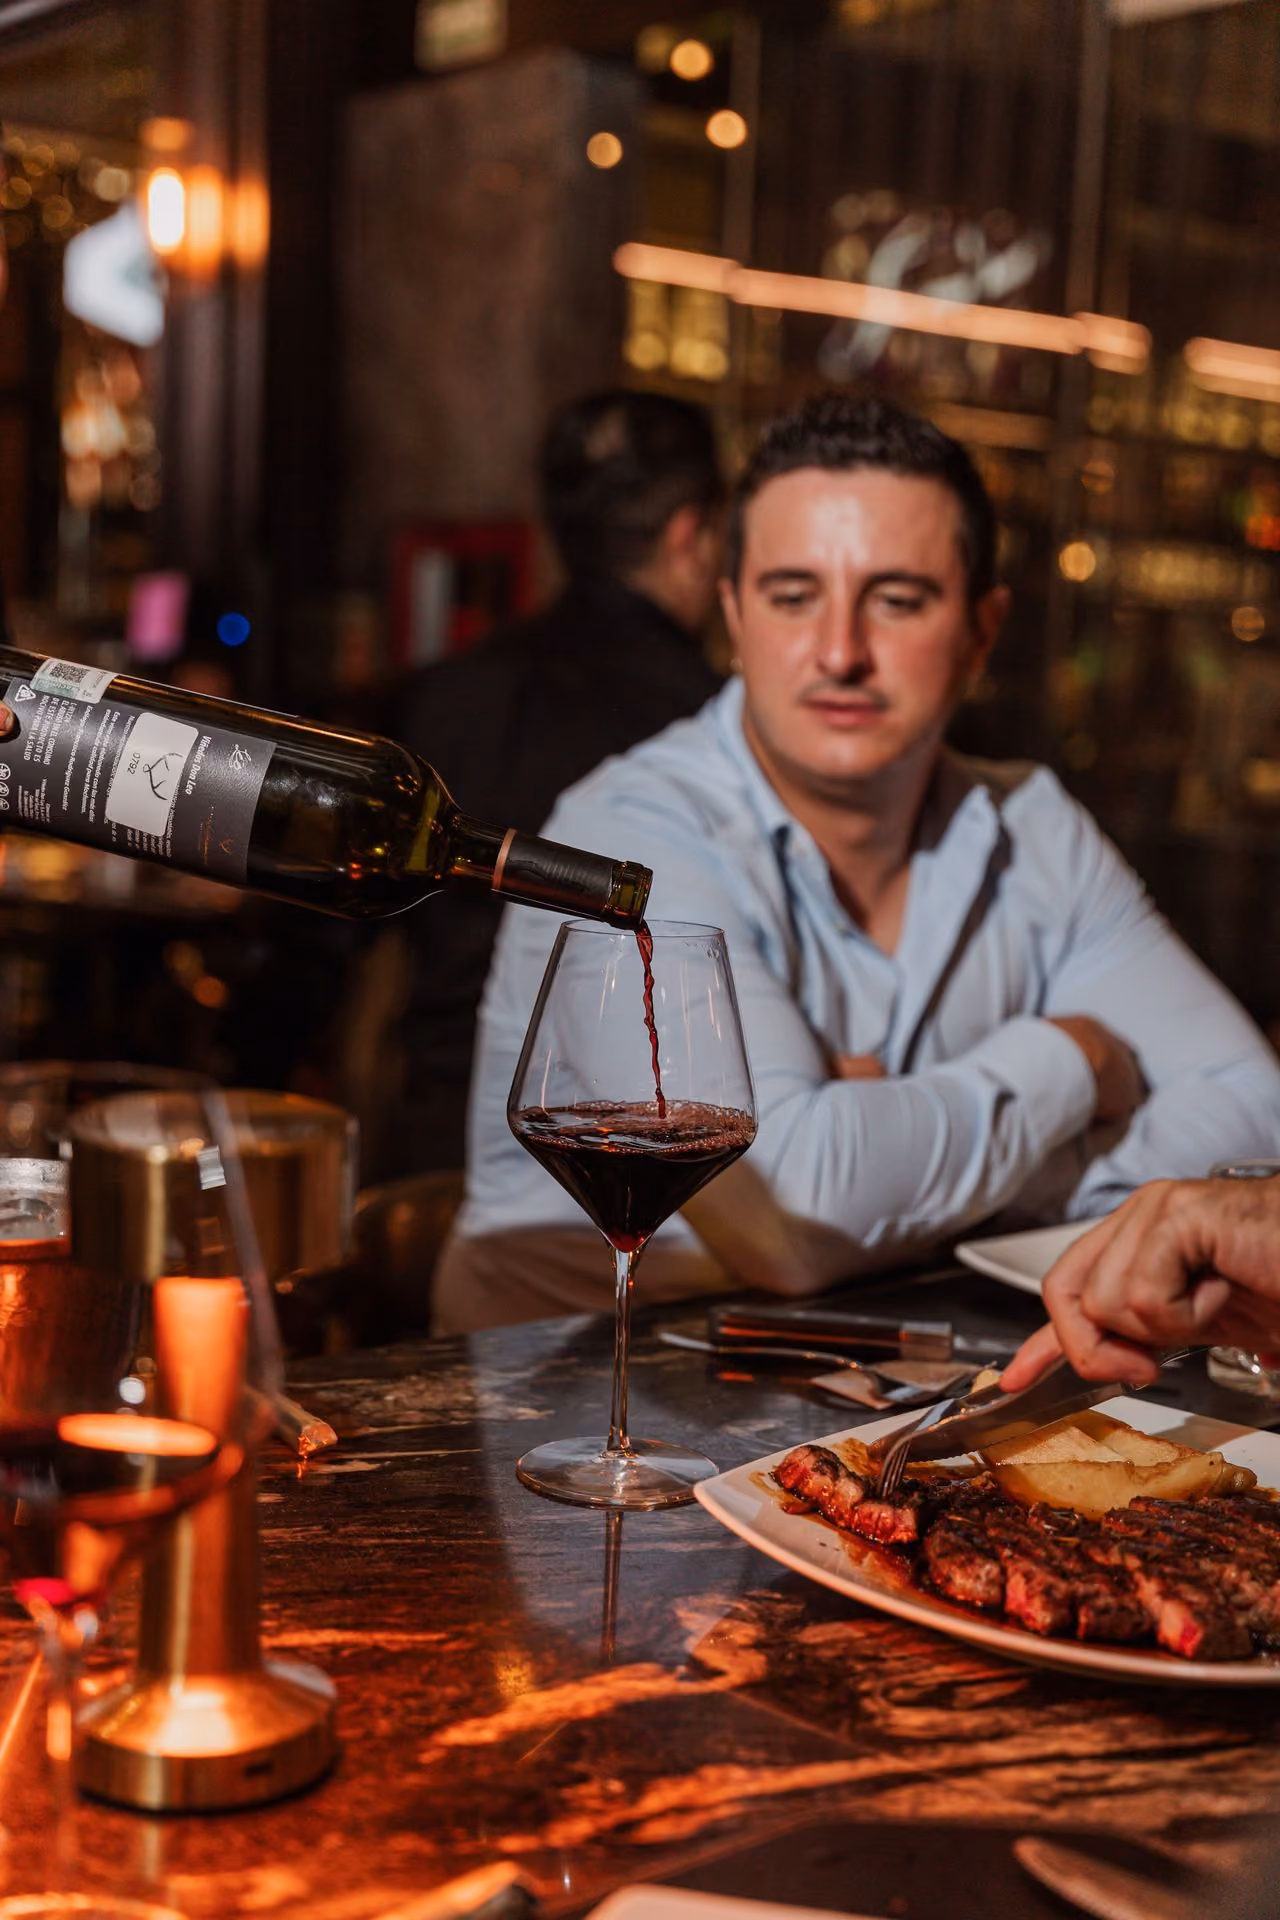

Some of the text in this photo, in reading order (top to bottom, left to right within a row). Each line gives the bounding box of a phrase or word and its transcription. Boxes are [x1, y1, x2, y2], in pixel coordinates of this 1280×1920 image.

[22, 694, 50, 761] NOCIVO PARA LA SALUD
[32, 697, 60, 762] DE ESTE PRODUCTO ES
[54, 705, 66, 724] ABUSO
[42, 736, 56, 765] CONSUMO
[86, 745, 98, 768] calidad
[94, 746, 106, 778] elaborado
[126, 751, 141, 775] 0792
[184, 735, 211, 795] Viñedos Don Leo
